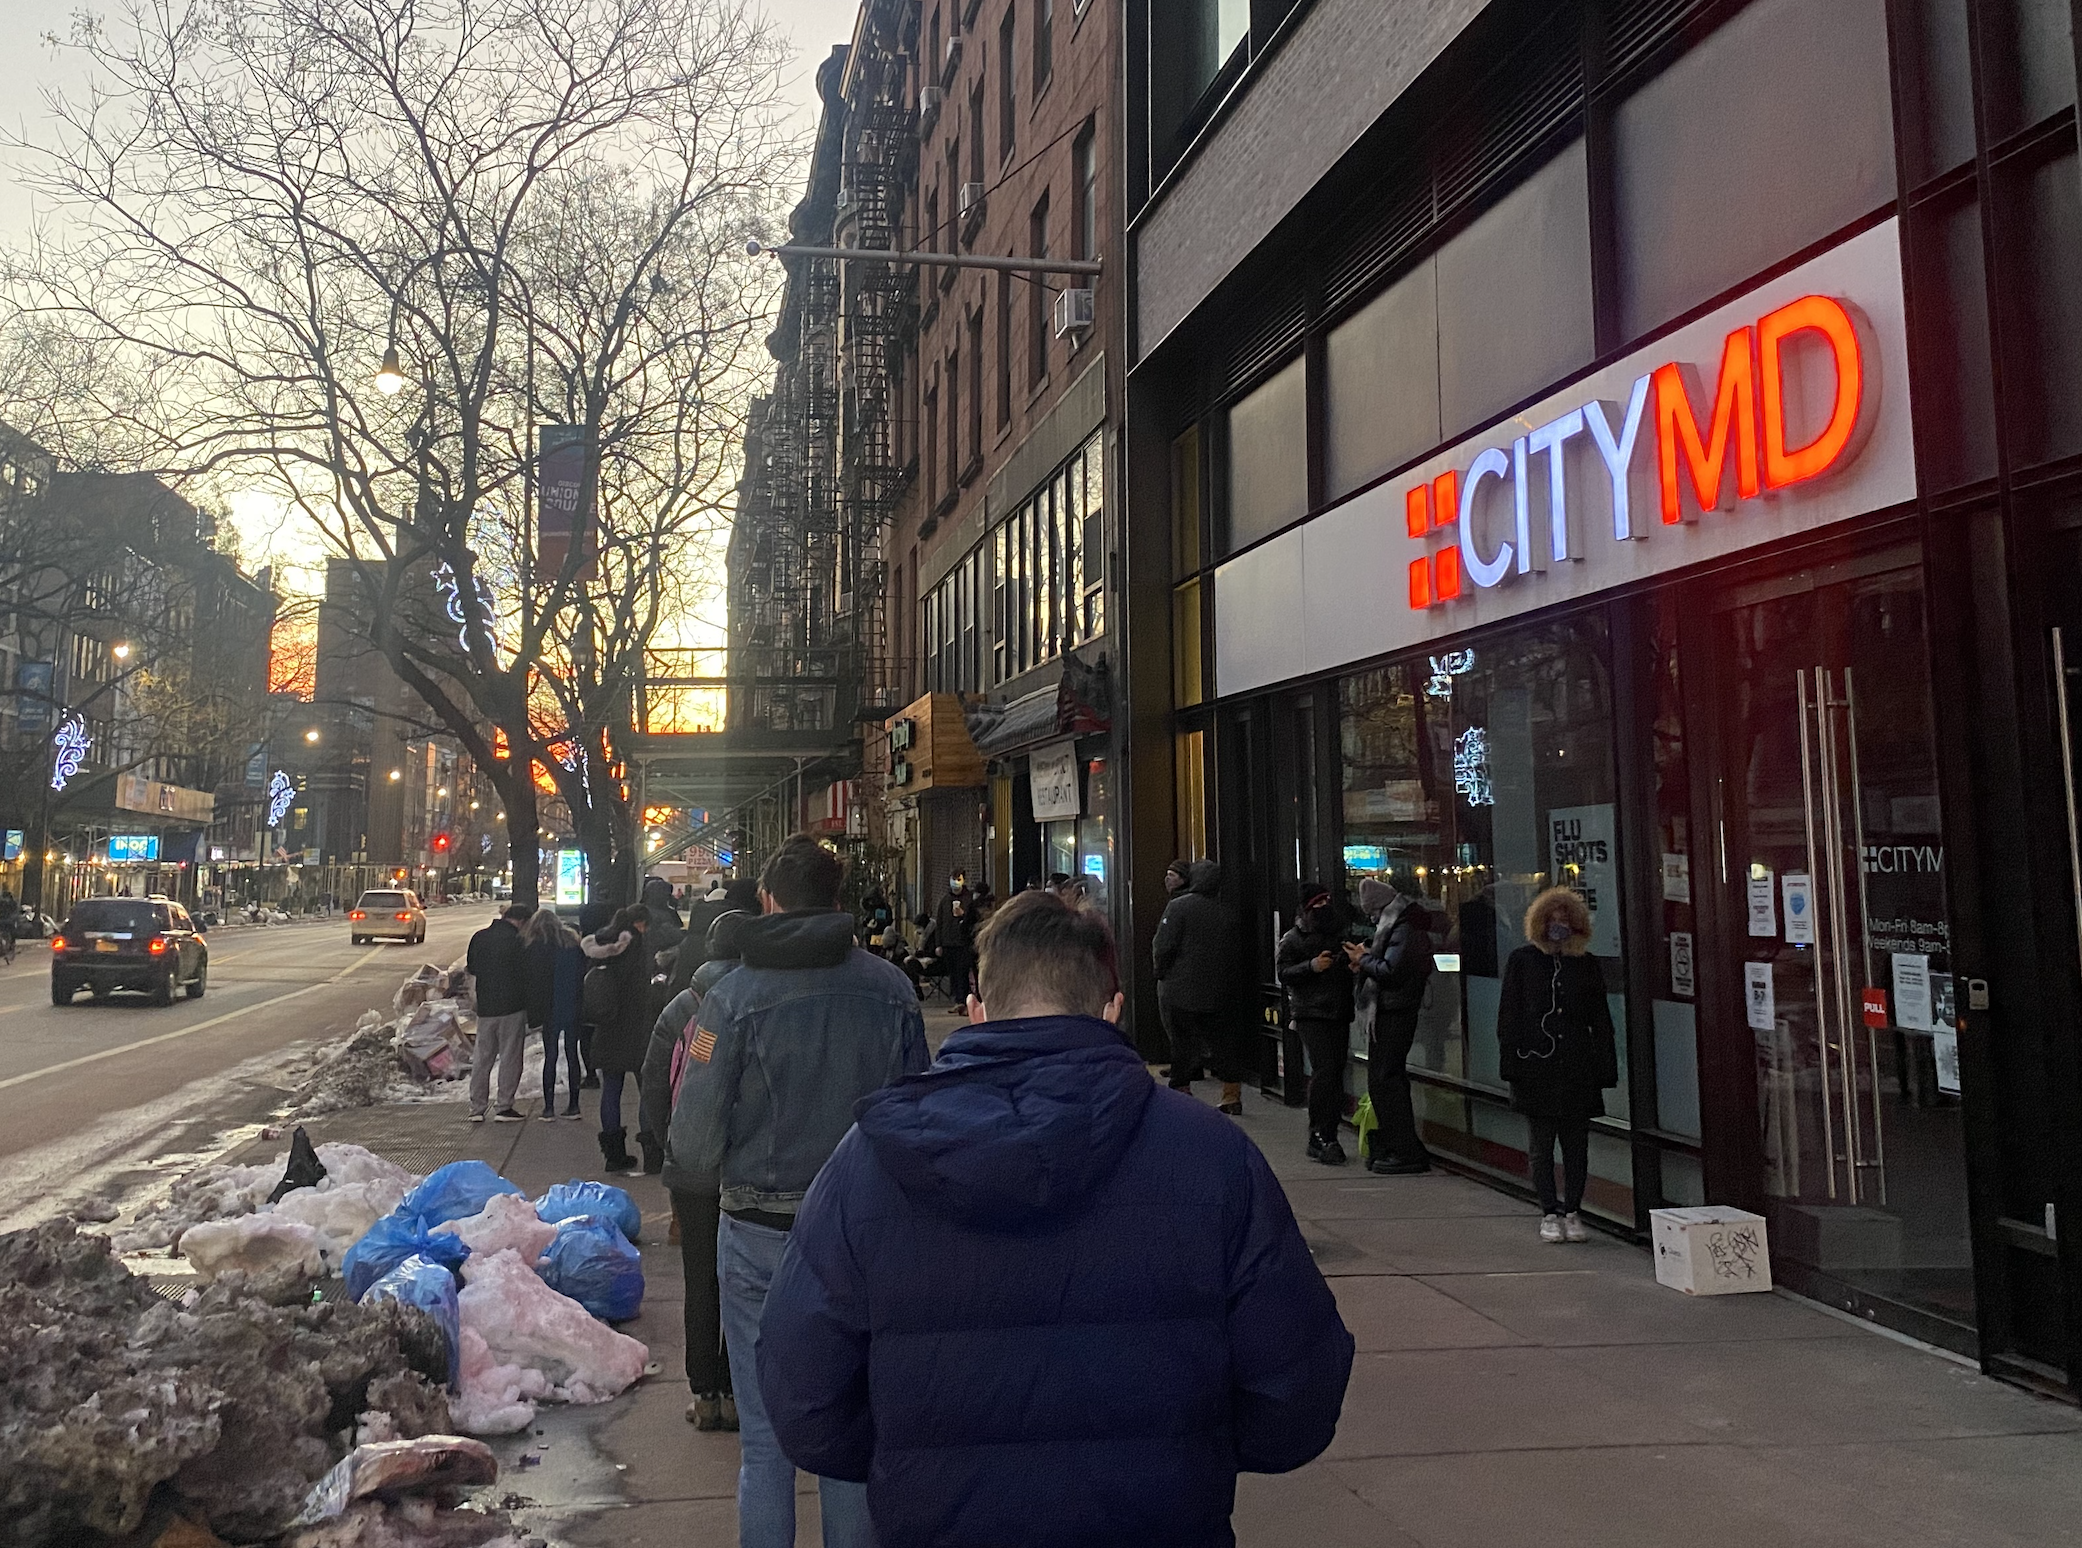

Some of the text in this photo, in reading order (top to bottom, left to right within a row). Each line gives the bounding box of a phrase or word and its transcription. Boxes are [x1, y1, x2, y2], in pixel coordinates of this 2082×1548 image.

[1459, 295, 1861, 587] CITYMD
[541, 485, 580, 500] UNION
[544, 497, 597, 514] SQUAE
[1553, 819, 1581, 842] FLU
[1555, 841, 1608, 865] SHOTS
[1878, 846, 1944, 873] CITYM
[1869, 918, 1908, 933] Mon-Fri
[1863, 1002, 1885, 1014] PULL
